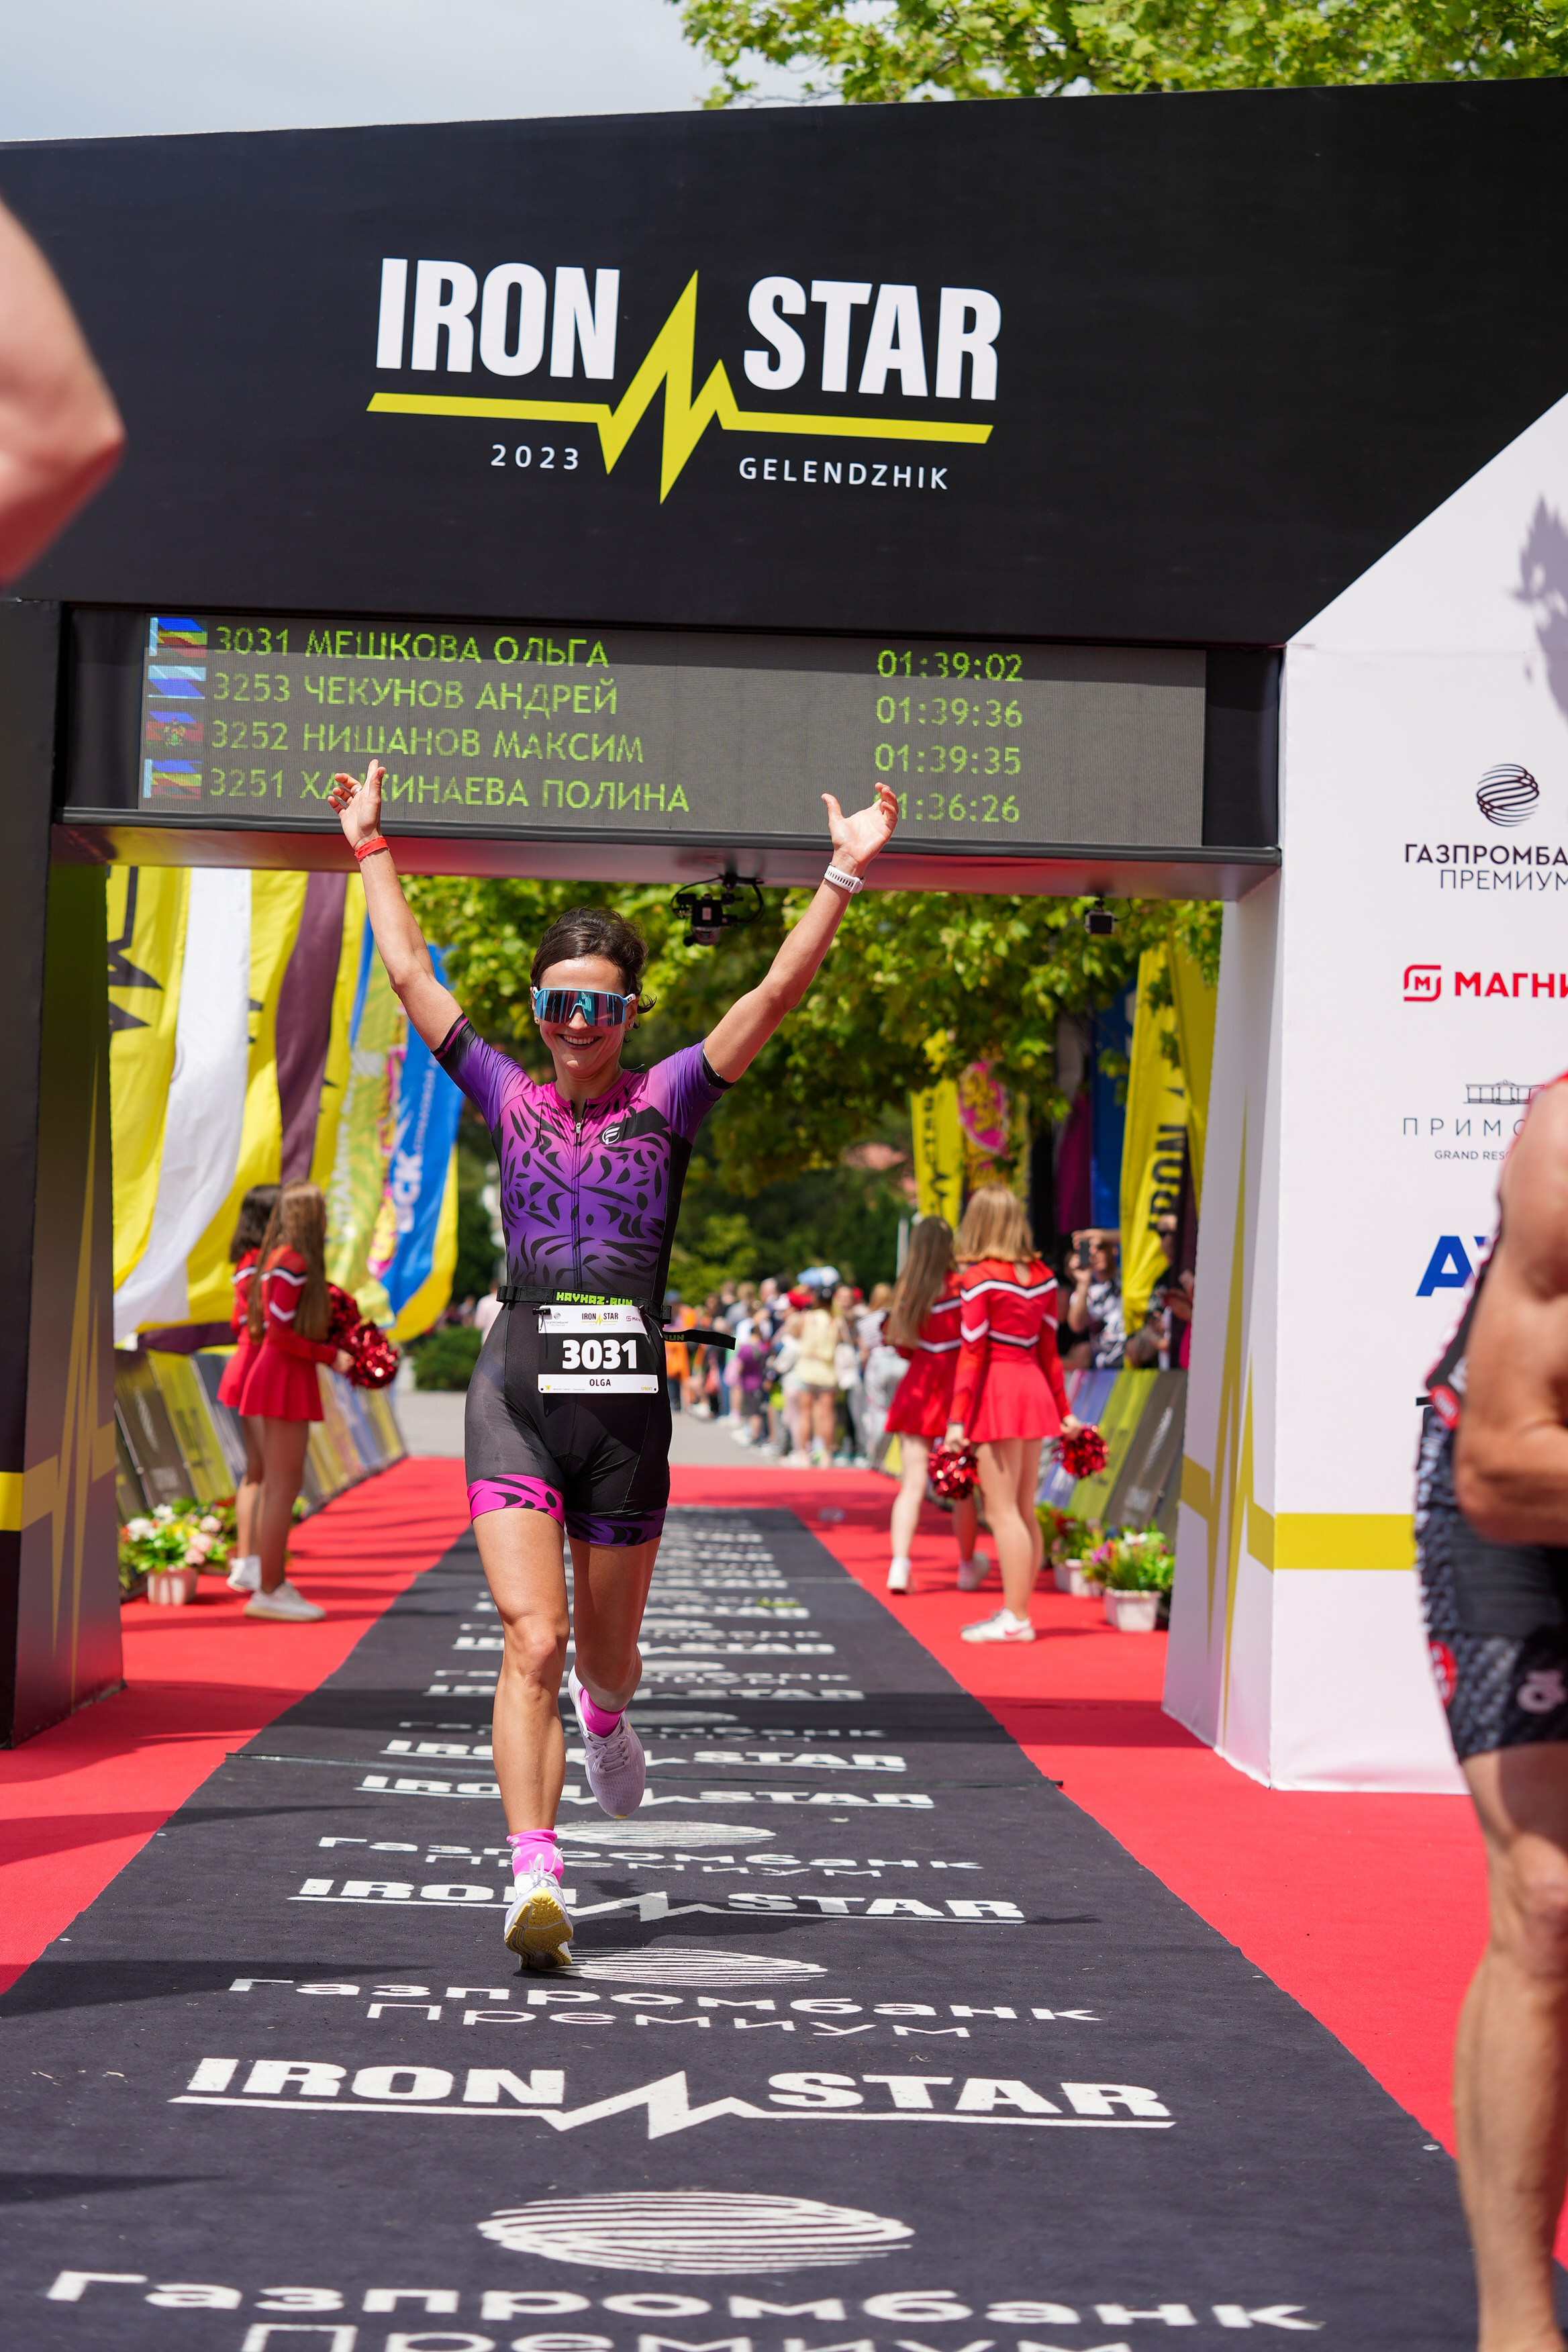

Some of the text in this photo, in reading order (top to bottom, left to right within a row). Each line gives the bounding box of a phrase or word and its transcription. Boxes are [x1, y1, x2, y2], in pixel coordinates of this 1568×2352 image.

[377, 258, 1001, 401] IRON STAR
[491, 444, 948, 490] 2023 GELENDZHIK
[216, 626, 1024, 681] 3031 МЕШКОВА ОЛЬГА 01:39:02
[214, 672, 1023, 727] 3253 ЧЕКУНОВ АНДРЕЙ 01:39:36
[212, 720, 1022, 775] 3252 НИШАНОВ МАКСИМ 01:39:35
[210, 767, 1020, 823] 3251 ХАИНАЕВА ПОЛИНА 1:36:26
[1434, 1150, 1479, 1161] GRAND
[562, 1338, 637, 1370] 3031
[589, 1379, 611, 1387] OLGA
[699, 1790, 935, 1808] STAR
[727, 1892, 1026, 1918] STAR
[228, 1978, 1104, 2021] Газпромбанк
[366, 2003, 971, 2038] Премиум
[186, 2057, 1173, 2117] IRON STAR
[46, 2270, 1326, 2331] Газпромбанк
